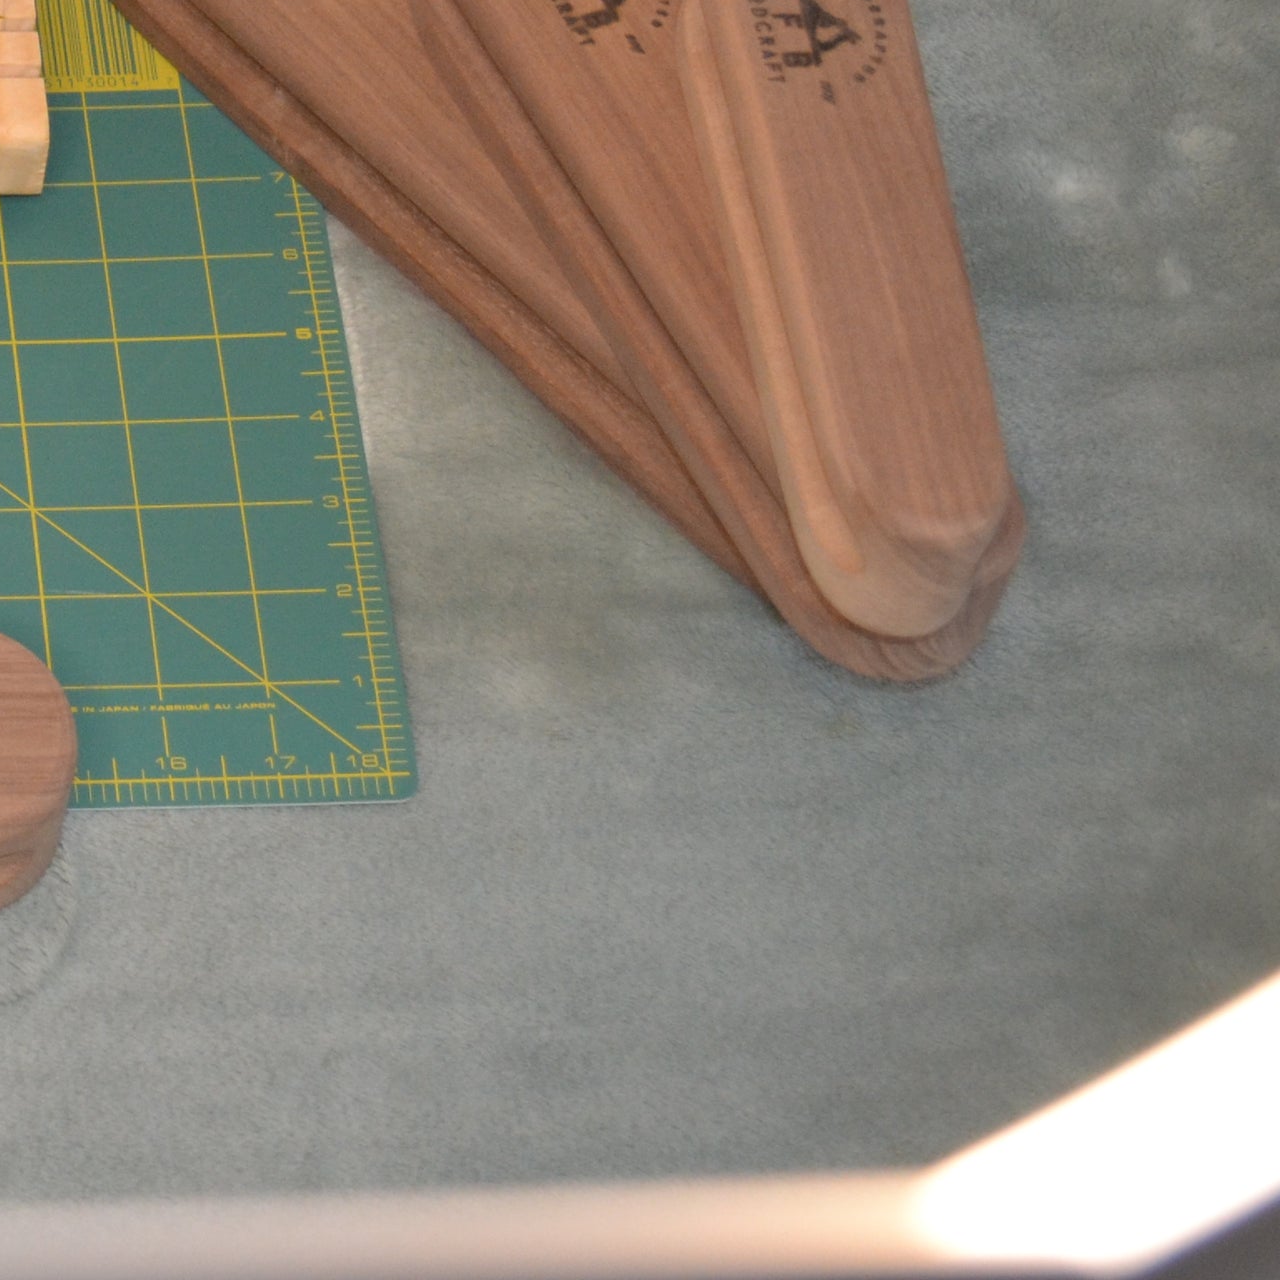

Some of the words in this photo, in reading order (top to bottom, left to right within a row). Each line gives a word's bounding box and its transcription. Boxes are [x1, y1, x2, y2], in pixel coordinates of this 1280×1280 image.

[309, 410, 324, 422] 4
[322, 496, 340, 508] 3
[336, 584, 353, 597] 2
[99, 705, 140, 713] JAPAN
[235, 702, 276, 710] JAPON
[155, 757, 187, 770] 16
[265, 756, 295, 769] 17
[347, 754, 379, 768] 18
